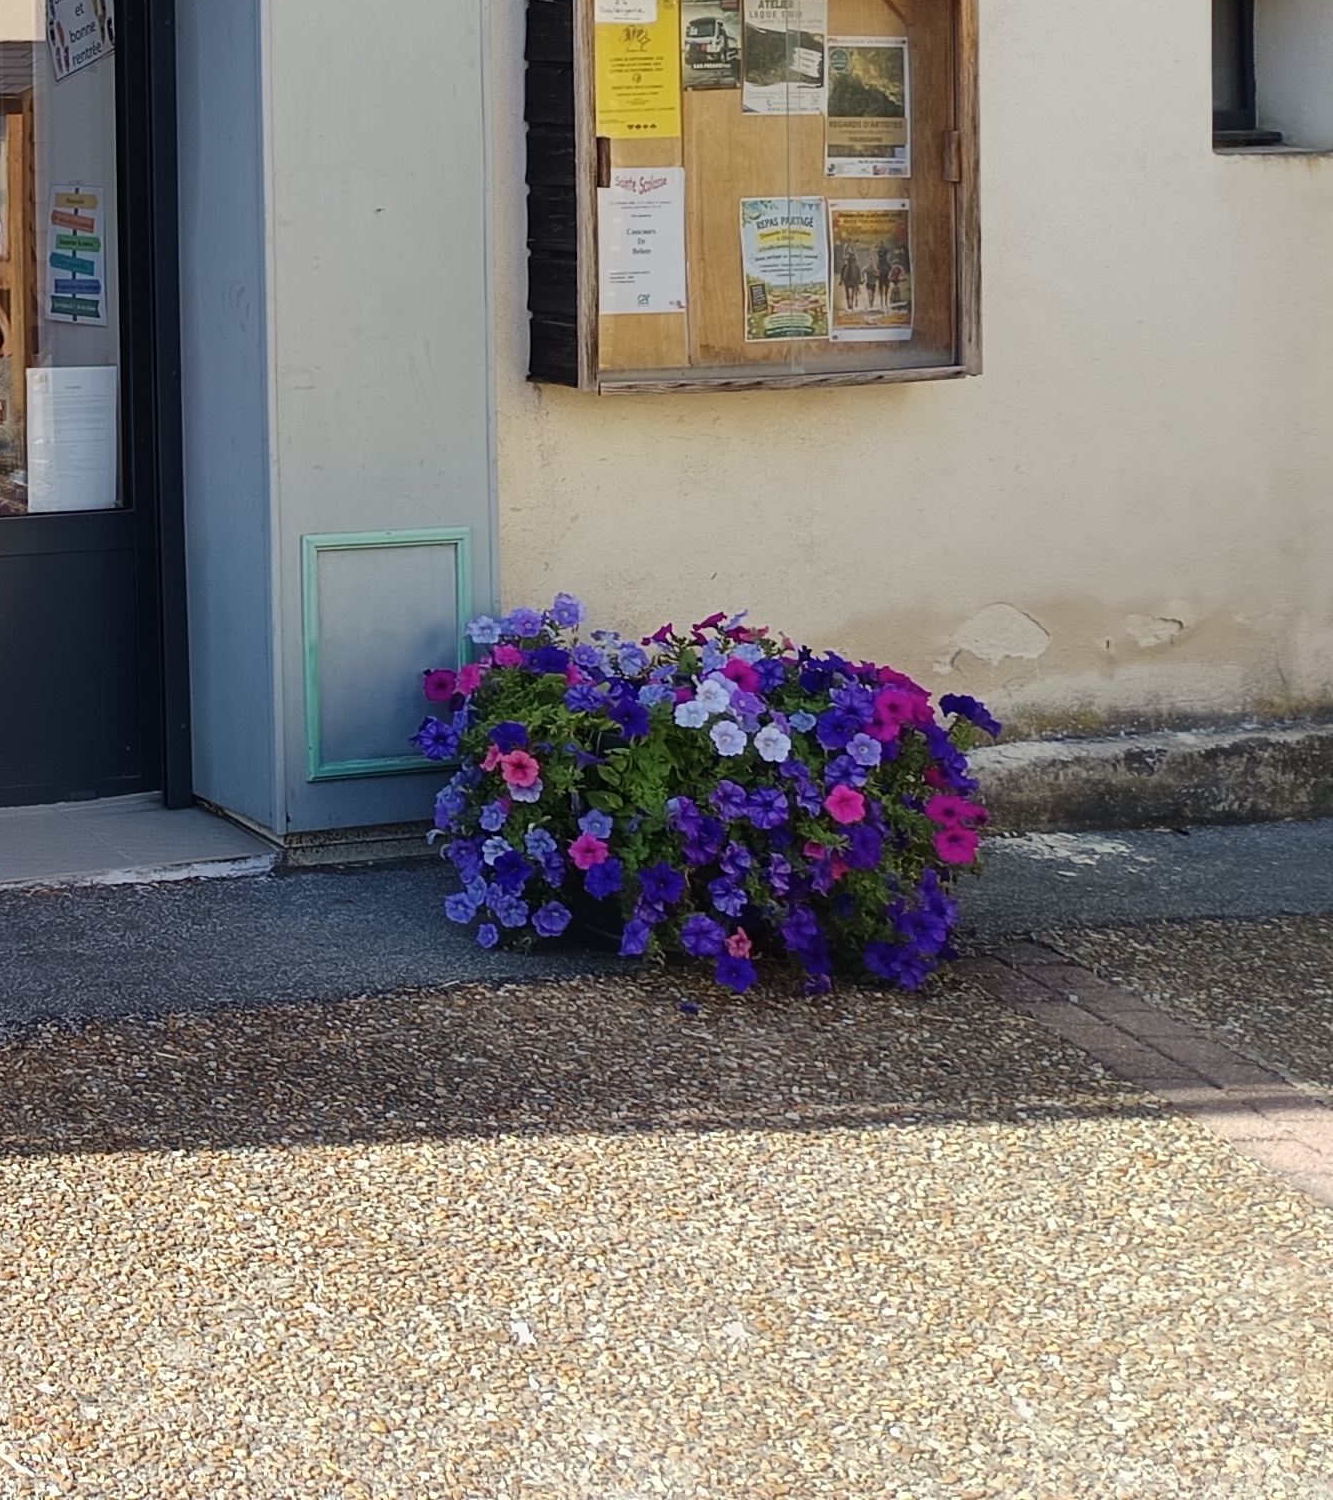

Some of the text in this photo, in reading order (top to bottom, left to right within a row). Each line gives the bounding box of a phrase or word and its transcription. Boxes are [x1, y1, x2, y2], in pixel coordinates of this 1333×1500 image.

[75, 3, 84, 17] et
[758, 0, 794, 9] ATELIER
[749, 11, 777, 19] LAQUE
[69, 21, 96, 43] bonne
[72, 41, 102, 67] rentrée
[614, 175, 667, 195] Sainte Scolasse
[756, 215, 814, 230] REPAS PARTAGÉ
